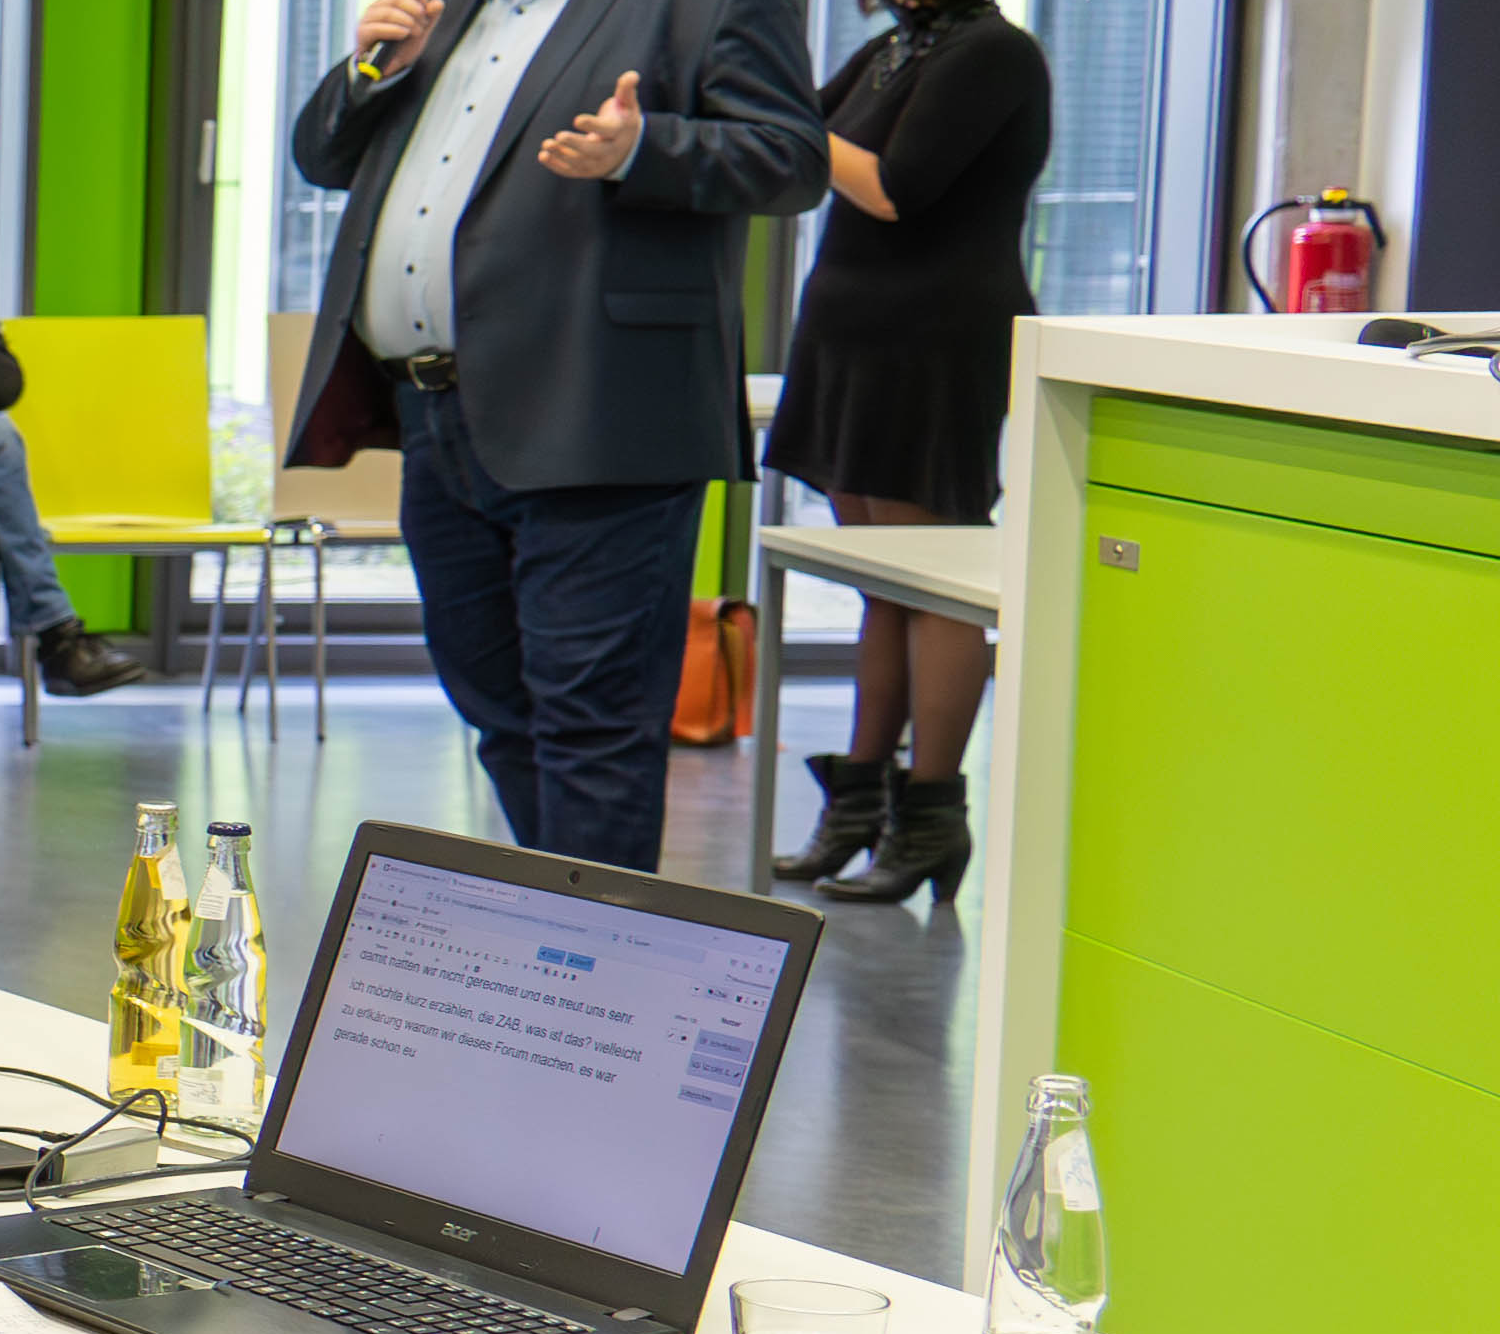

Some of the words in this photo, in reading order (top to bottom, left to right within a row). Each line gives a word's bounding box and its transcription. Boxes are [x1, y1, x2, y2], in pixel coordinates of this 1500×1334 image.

[422, 964, 438, 976] wir
[465, 974, 519, 997] gerechnet
[520, 987, 541, 1002] und
[542, 994, 557, 1006] es
[585, 1005, 606, 1018] uns
[333, 1027, 369, 1046] gerade
[370, 1035, 401, 1054] schon
[341, 1005, 354, 1016] zu
[404, 1020, 439, 1038] warum
[440, 1028, 457, 1042] wir
[458, 1032, 493, 1051] dieses
[493, 1041, 528, 1061] Forum
[579, 1064, 593, 1078] es
[595, 1068, 617, 1082] war
[404, 992, 427, 1008] kurz
[478, 1010, 494, 1024] die
[525, 1024, 547, 1038] was
[549, 1028, 562, 1042] ist
[564, 1032, 591, 1048] das?
[593, 1039, 643, 1062] vielleicht
[440, 1221, 479, 1243] acer
